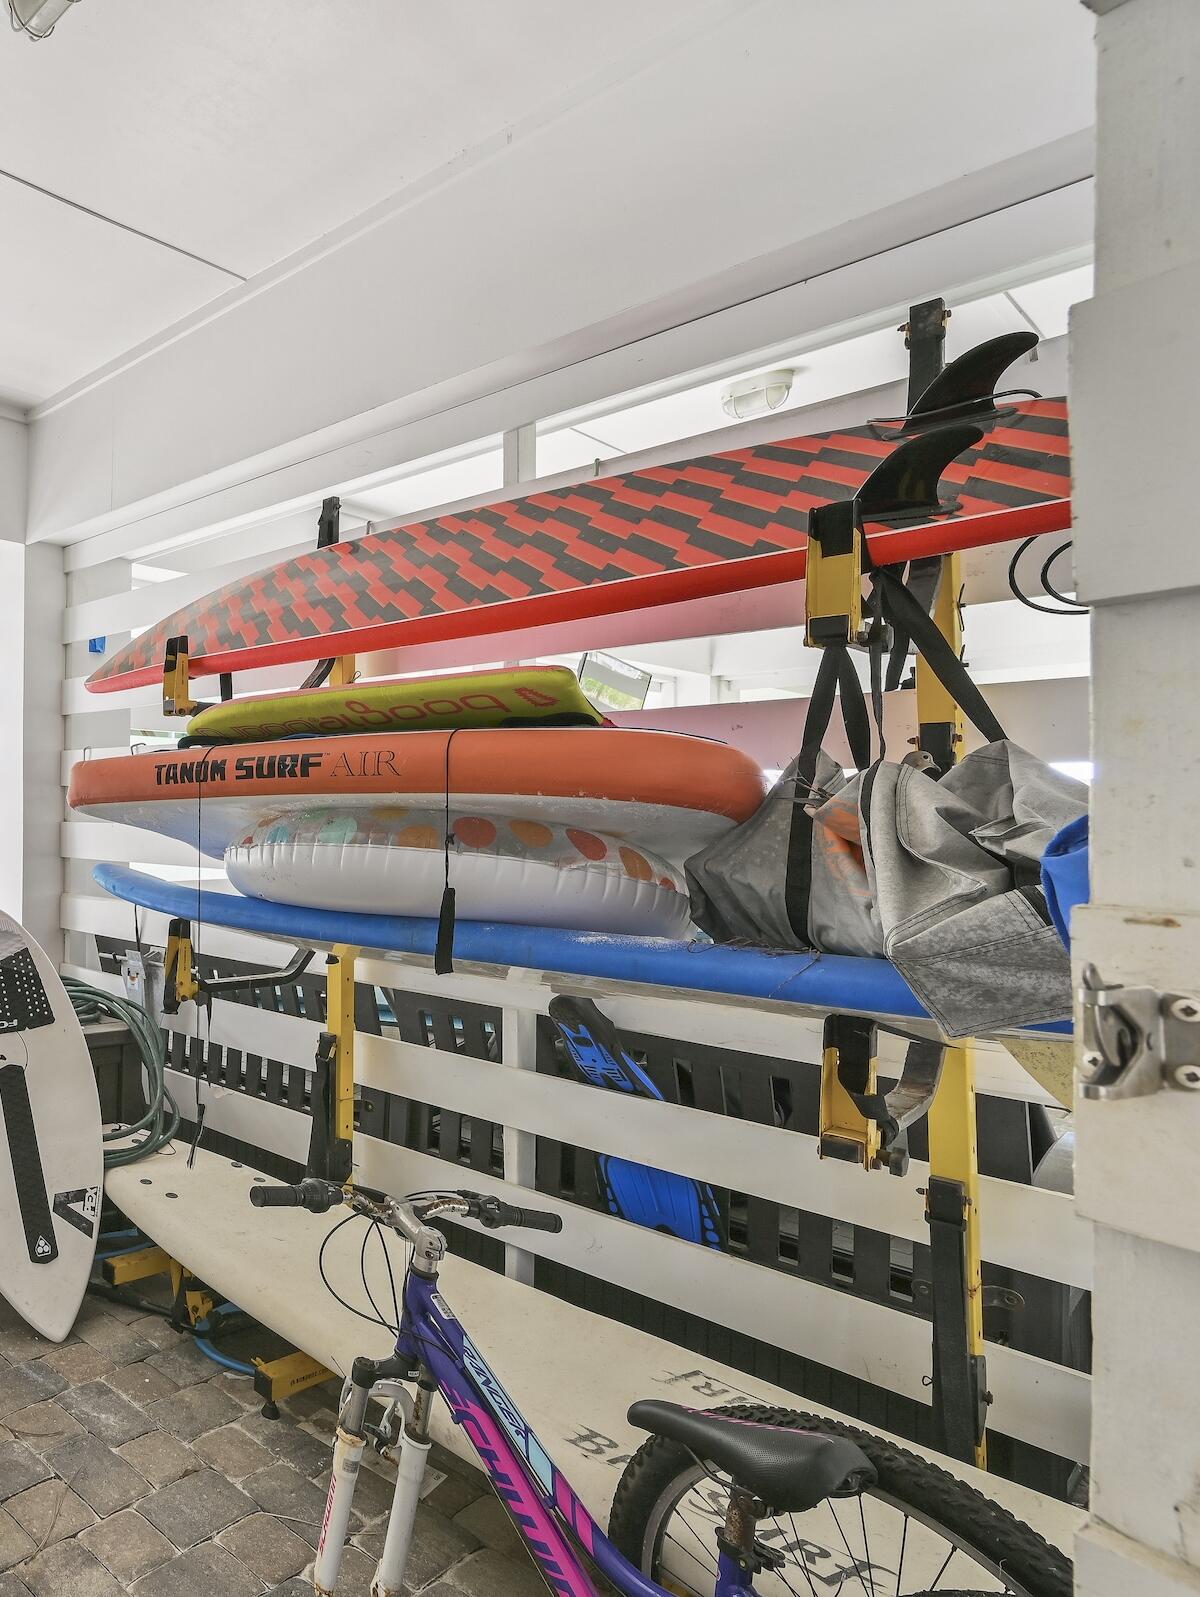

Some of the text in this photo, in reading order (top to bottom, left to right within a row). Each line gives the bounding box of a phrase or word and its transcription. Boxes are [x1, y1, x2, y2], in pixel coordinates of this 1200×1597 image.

[235, 752, 323, 780] SURF
[330, 750, 401, 777] AIR
[439, 1378, 576, 1597] SCHWI
